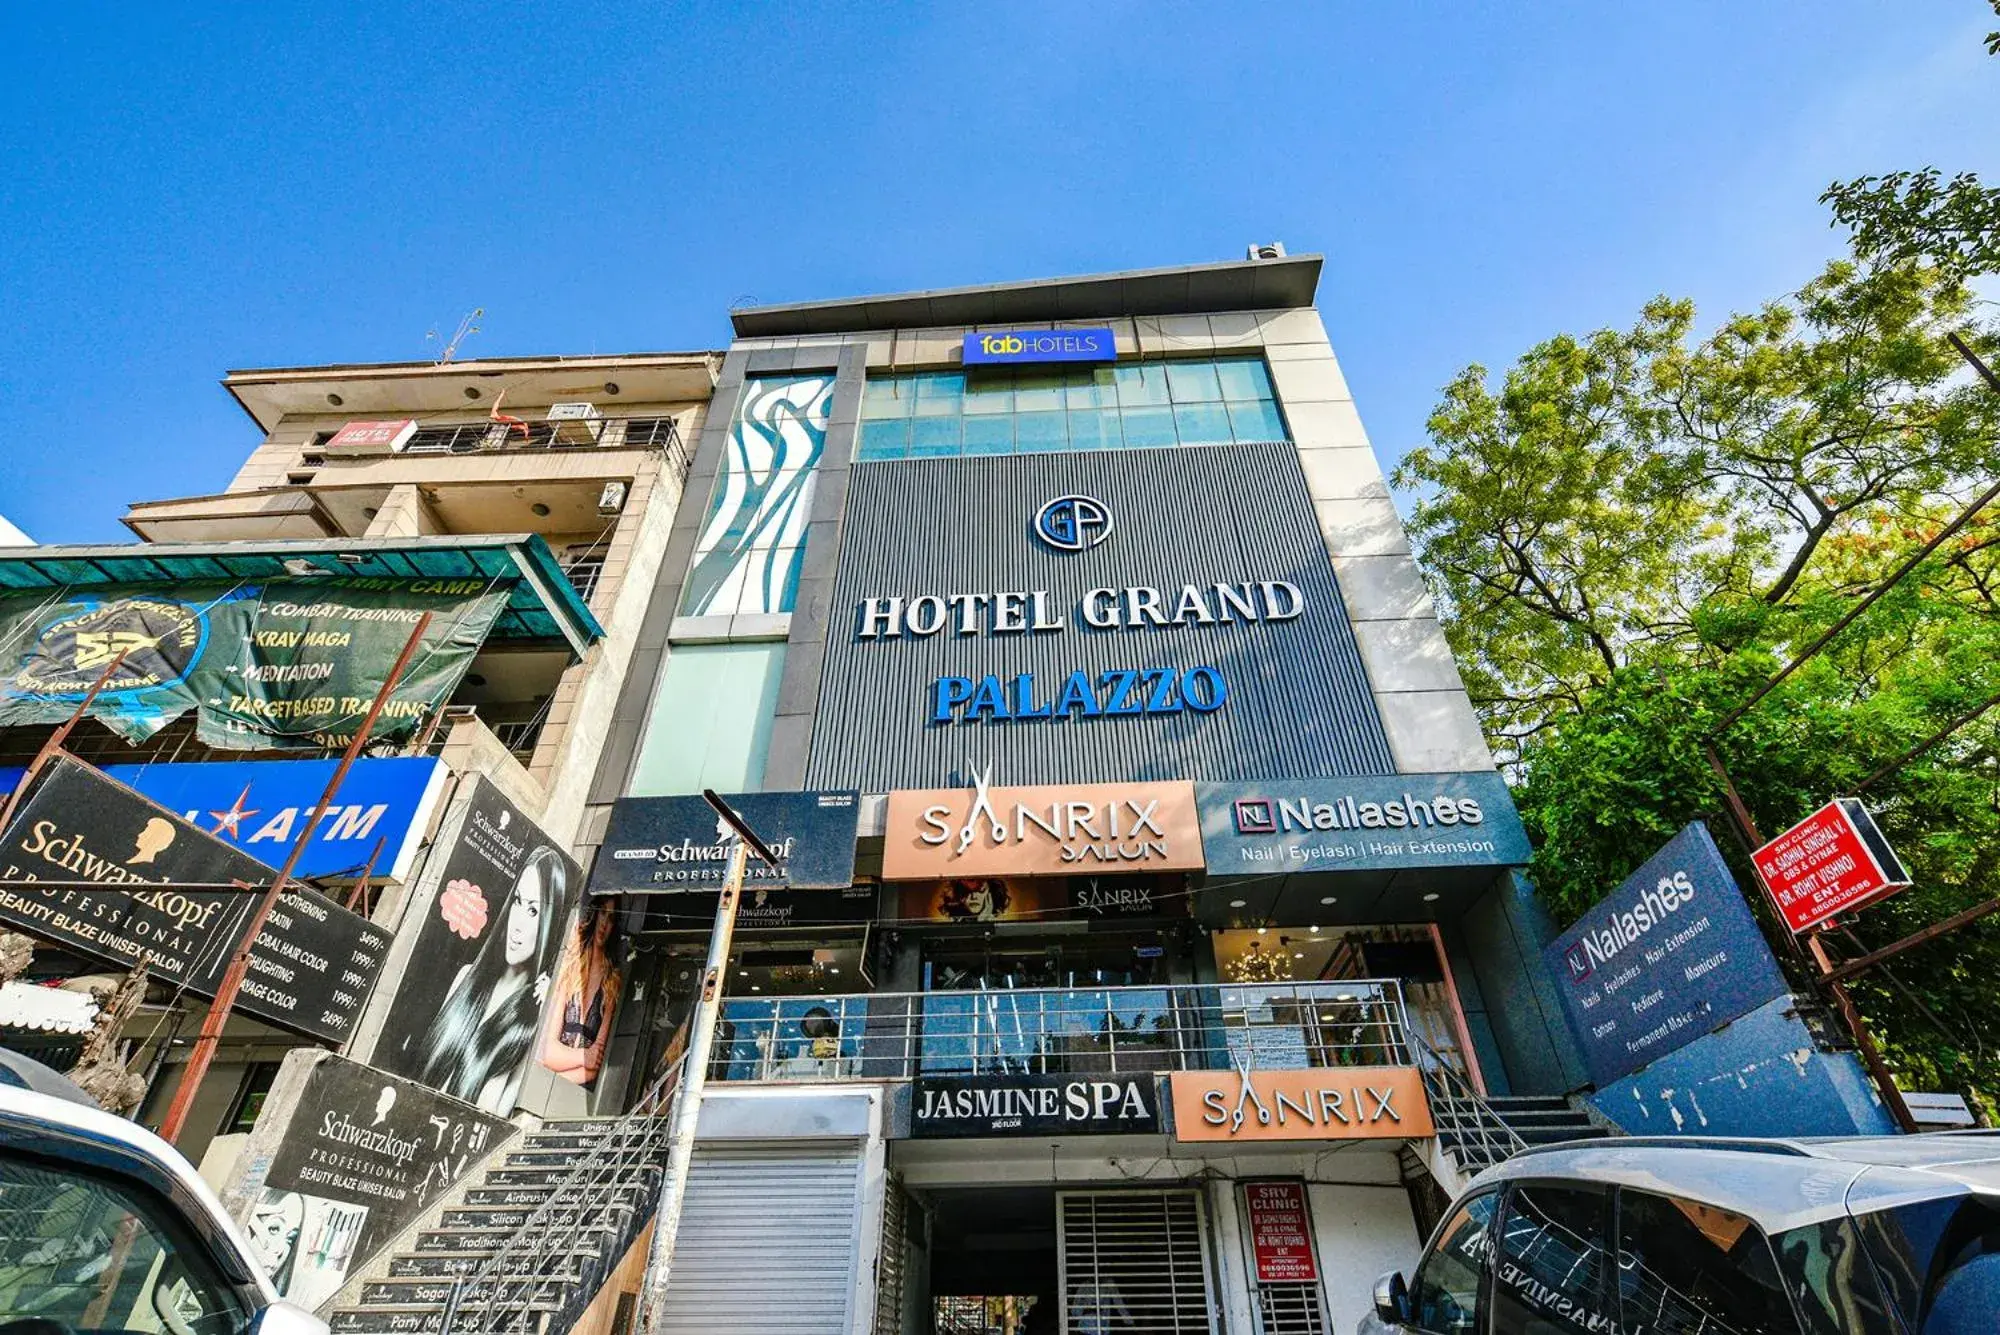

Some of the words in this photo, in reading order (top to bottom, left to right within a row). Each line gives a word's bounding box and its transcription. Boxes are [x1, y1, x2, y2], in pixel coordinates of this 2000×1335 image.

[981, 335, 1098, 355] fabHOTELS
[409, 579, 484, 595] CAMP
[271, 602, 344, 618] COMBAT
[344, 607, 424, 623] TRAINING
[859, 591, 1064, 637] HOTEL
[1082, 580, 1305, 628] GRAND
[255, 630, 302, 648] KRAV
[302, 632, 351, 647] MAGA
[102, 673, 160, 689] THEME
[242, 662, 335, 682] MEDITATION
[934, 665, 1226, 721] PALAZZO
[339, 697, 427, 718] TRANING
[246, 804, 389, 843] ATM
[920, 771, 1165, 855] SANRIX
[1277, 794, 1485, 832] Nailashes
[473, 810, 525, 860] Schwarzkopf
[1791, 821, 1820, 843] CLINIC
[658, 837, 794, 862] Schwarpf
[1061, 843, 1168, 862] SALON
[1242, 847, 1273, 862] Nail
[1290, 844, 1356, 863] Eyelash
[1370, 841, 1404, 856] Hair
[1410, 839, 1494, 855] Extension
[1783, 865, 1801, 881] OBS
[1801, 860, 1809, 871] &
[1808, 842, 1839, 866] GYNAE
[653, 867, 789, 882] PROFESONAL
[1791, 873, 1820, 899] ROHIT
[1812, 881, 1841, 903] ENT
[278, 892, 329, 922] OOTHENING
[739, 905, 793, 919] hwarzkopf
[1583, 871, 1695, 969] Nailashes
[0, 889, 55, 921] BEAUTY
[52, 912, 99, 940] BLAZE
[98, 930, 145, 959] UNISEX
[145, 948, 185, 973] SALON
[265, 909, 293, 931] RATIN
[351, 950, 376, 970] 1999/-
[254, 931, 283, 952] LOBAL
[282, 941, 302, 960] HAIR
[299, 951, 329, 974] COLOR
[341, 969, 367, 990] 1999/-
[1604, 964, 1641, 994] Eyelashes
[1645, 945, 1666, 967] Hair
[1664, 915, 1711, 952] Extension
[1684, 950, 1728, 982] Manicure
[240, 978, 267, 999] AYAGE
[266, 986, 297, 1011] COLOR
[246, 952, 295, 984] GHLIGHTING
[332, 990, 358, 1010] 1999/-
[1626, 1023, 1670, 1054] Permanent
[917, 1088, 1060, 1119] JASMINE
[1064, 1081, 1151, 1121] SPA
[1203, 1062, 1402, 1132] SANRIX
[318, 1110, 423, 1167] Schwarzkopf
[583, 1122, 612, 1132] Unisex
[310, 1148, 408, 1182] PROFESSIONAL
[299, 1166, 334, 1184] BEAUTY
[332, 1173, 358, 1191] BLAZE
[356, 1180, 384, 1196] UNISEX
[383, 1186, 407, 1200] SALON
[1259, 1187, 1289, 1198] SRV
[504, 1192, 549, 1203] Airbrush
[1252, 1199, 1300, 1210] CLINIC
[489, 1213, 523, 1224] Silicon
[458, 1237, 512, 1249] Traditiona
[391, 1315, 422, 1329] Party
[424, 1315, 480, 1333] Mae-up
